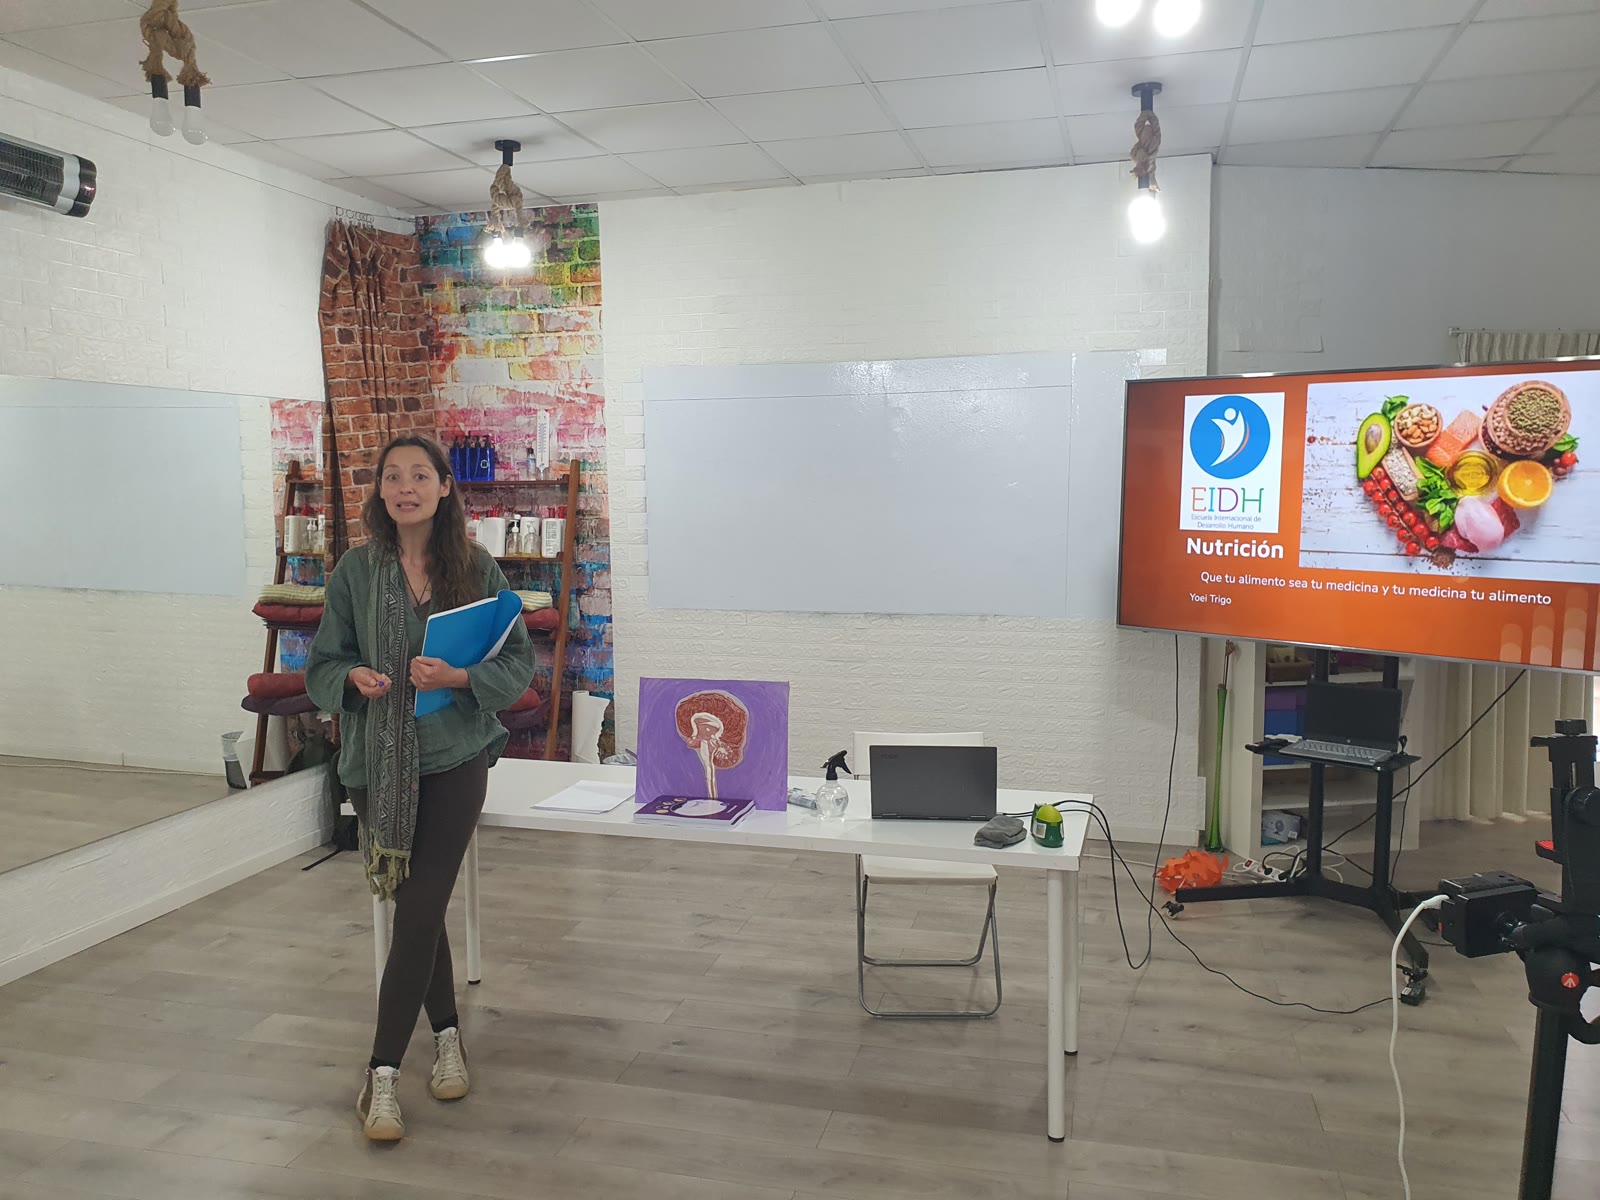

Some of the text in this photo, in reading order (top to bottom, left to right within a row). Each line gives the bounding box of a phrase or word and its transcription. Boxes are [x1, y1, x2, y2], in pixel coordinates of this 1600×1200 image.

[1191, 487, 1264, 513] EIDH
[1186, 537, 1284, 559] Nutrición
[1200, 571, 1552, 605] Que tu alimento sea tu medicina y tu medicina tu alimento
[1210, 594, 1232, 606] Trigo
